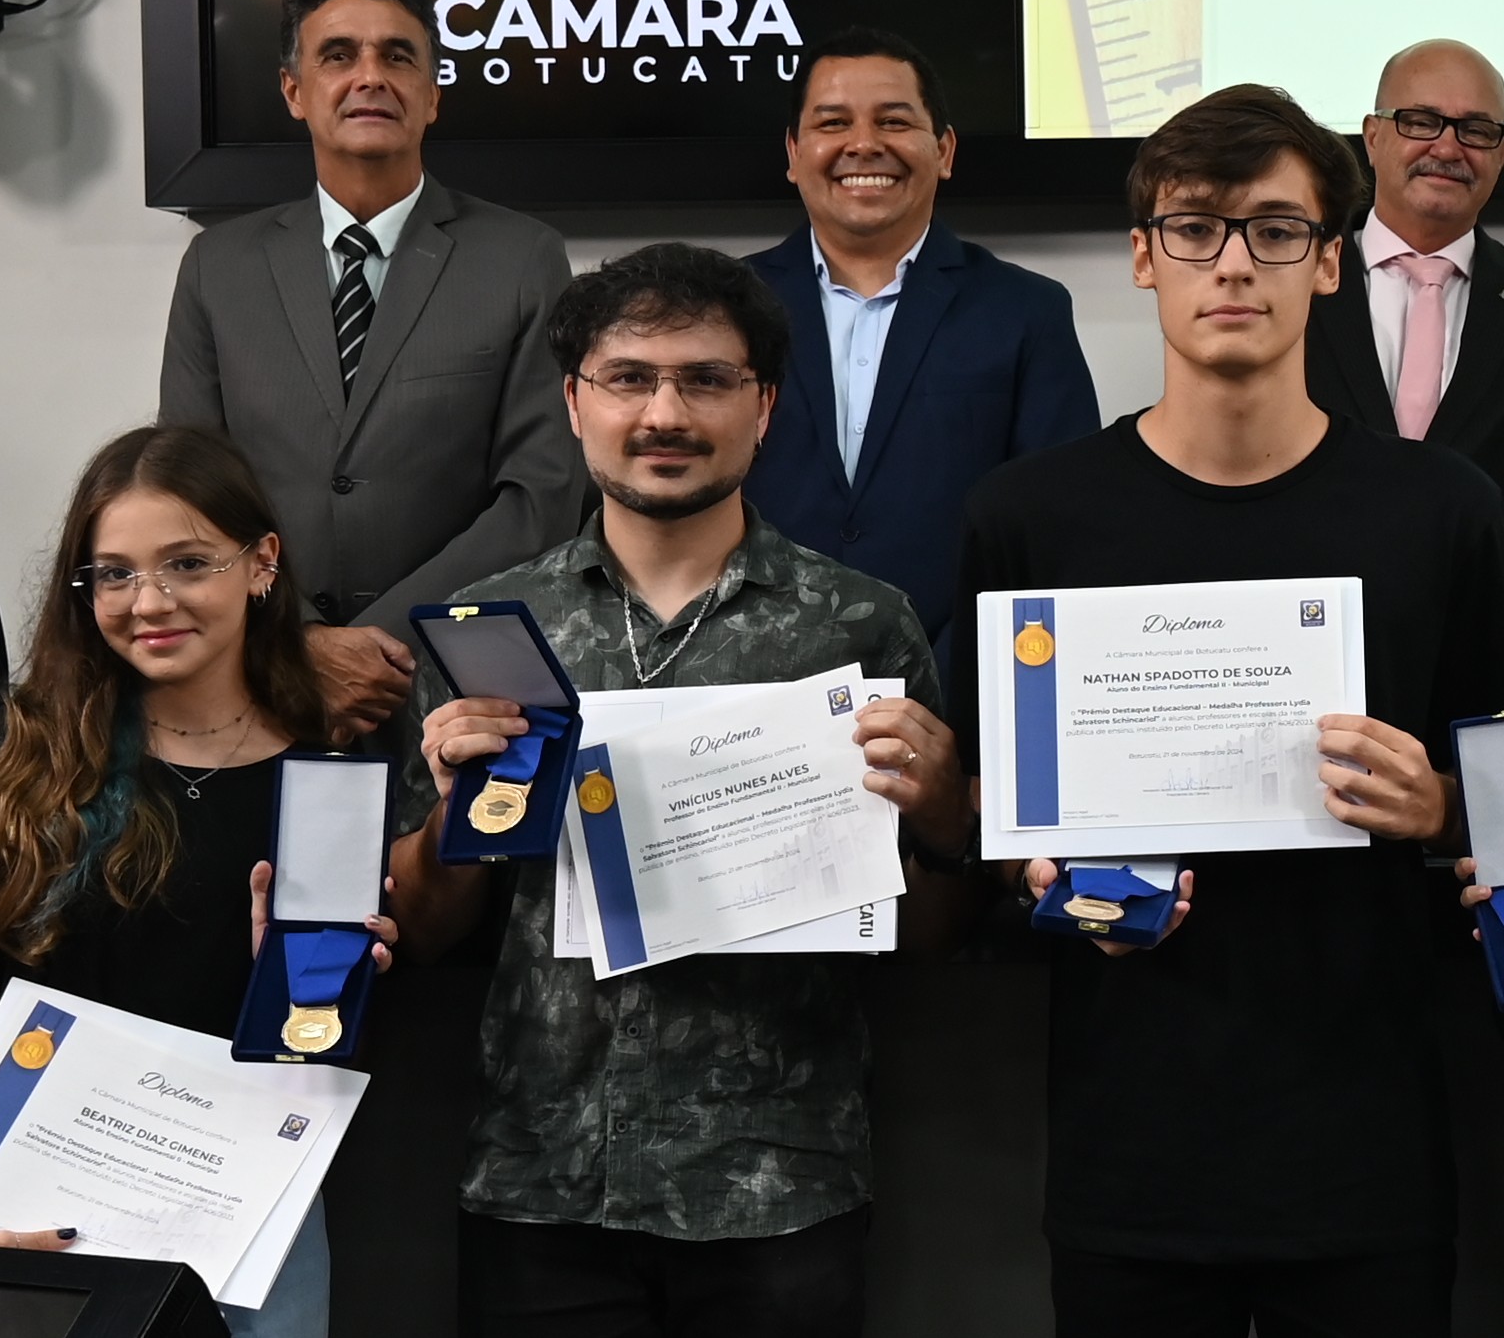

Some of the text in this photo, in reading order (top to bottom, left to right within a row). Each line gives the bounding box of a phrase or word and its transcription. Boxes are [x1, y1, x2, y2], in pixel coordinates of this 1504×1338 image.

[438, 56, 799, 84] BOTUCATU
[1143, 615, 1225, 635] Diploma
[1084, 666, 1292, 684] NATHAN SPADOTTO DE SOUZA
[690, 727, 763, 757] Diploma
[669, 764, 809, 812] VINÍCIUS NUNES ALVES
[138, 1072, 214, 1109] Diploma
[81, 1107, 224, 1165] BEATRIZ DIAZ GIMENES
